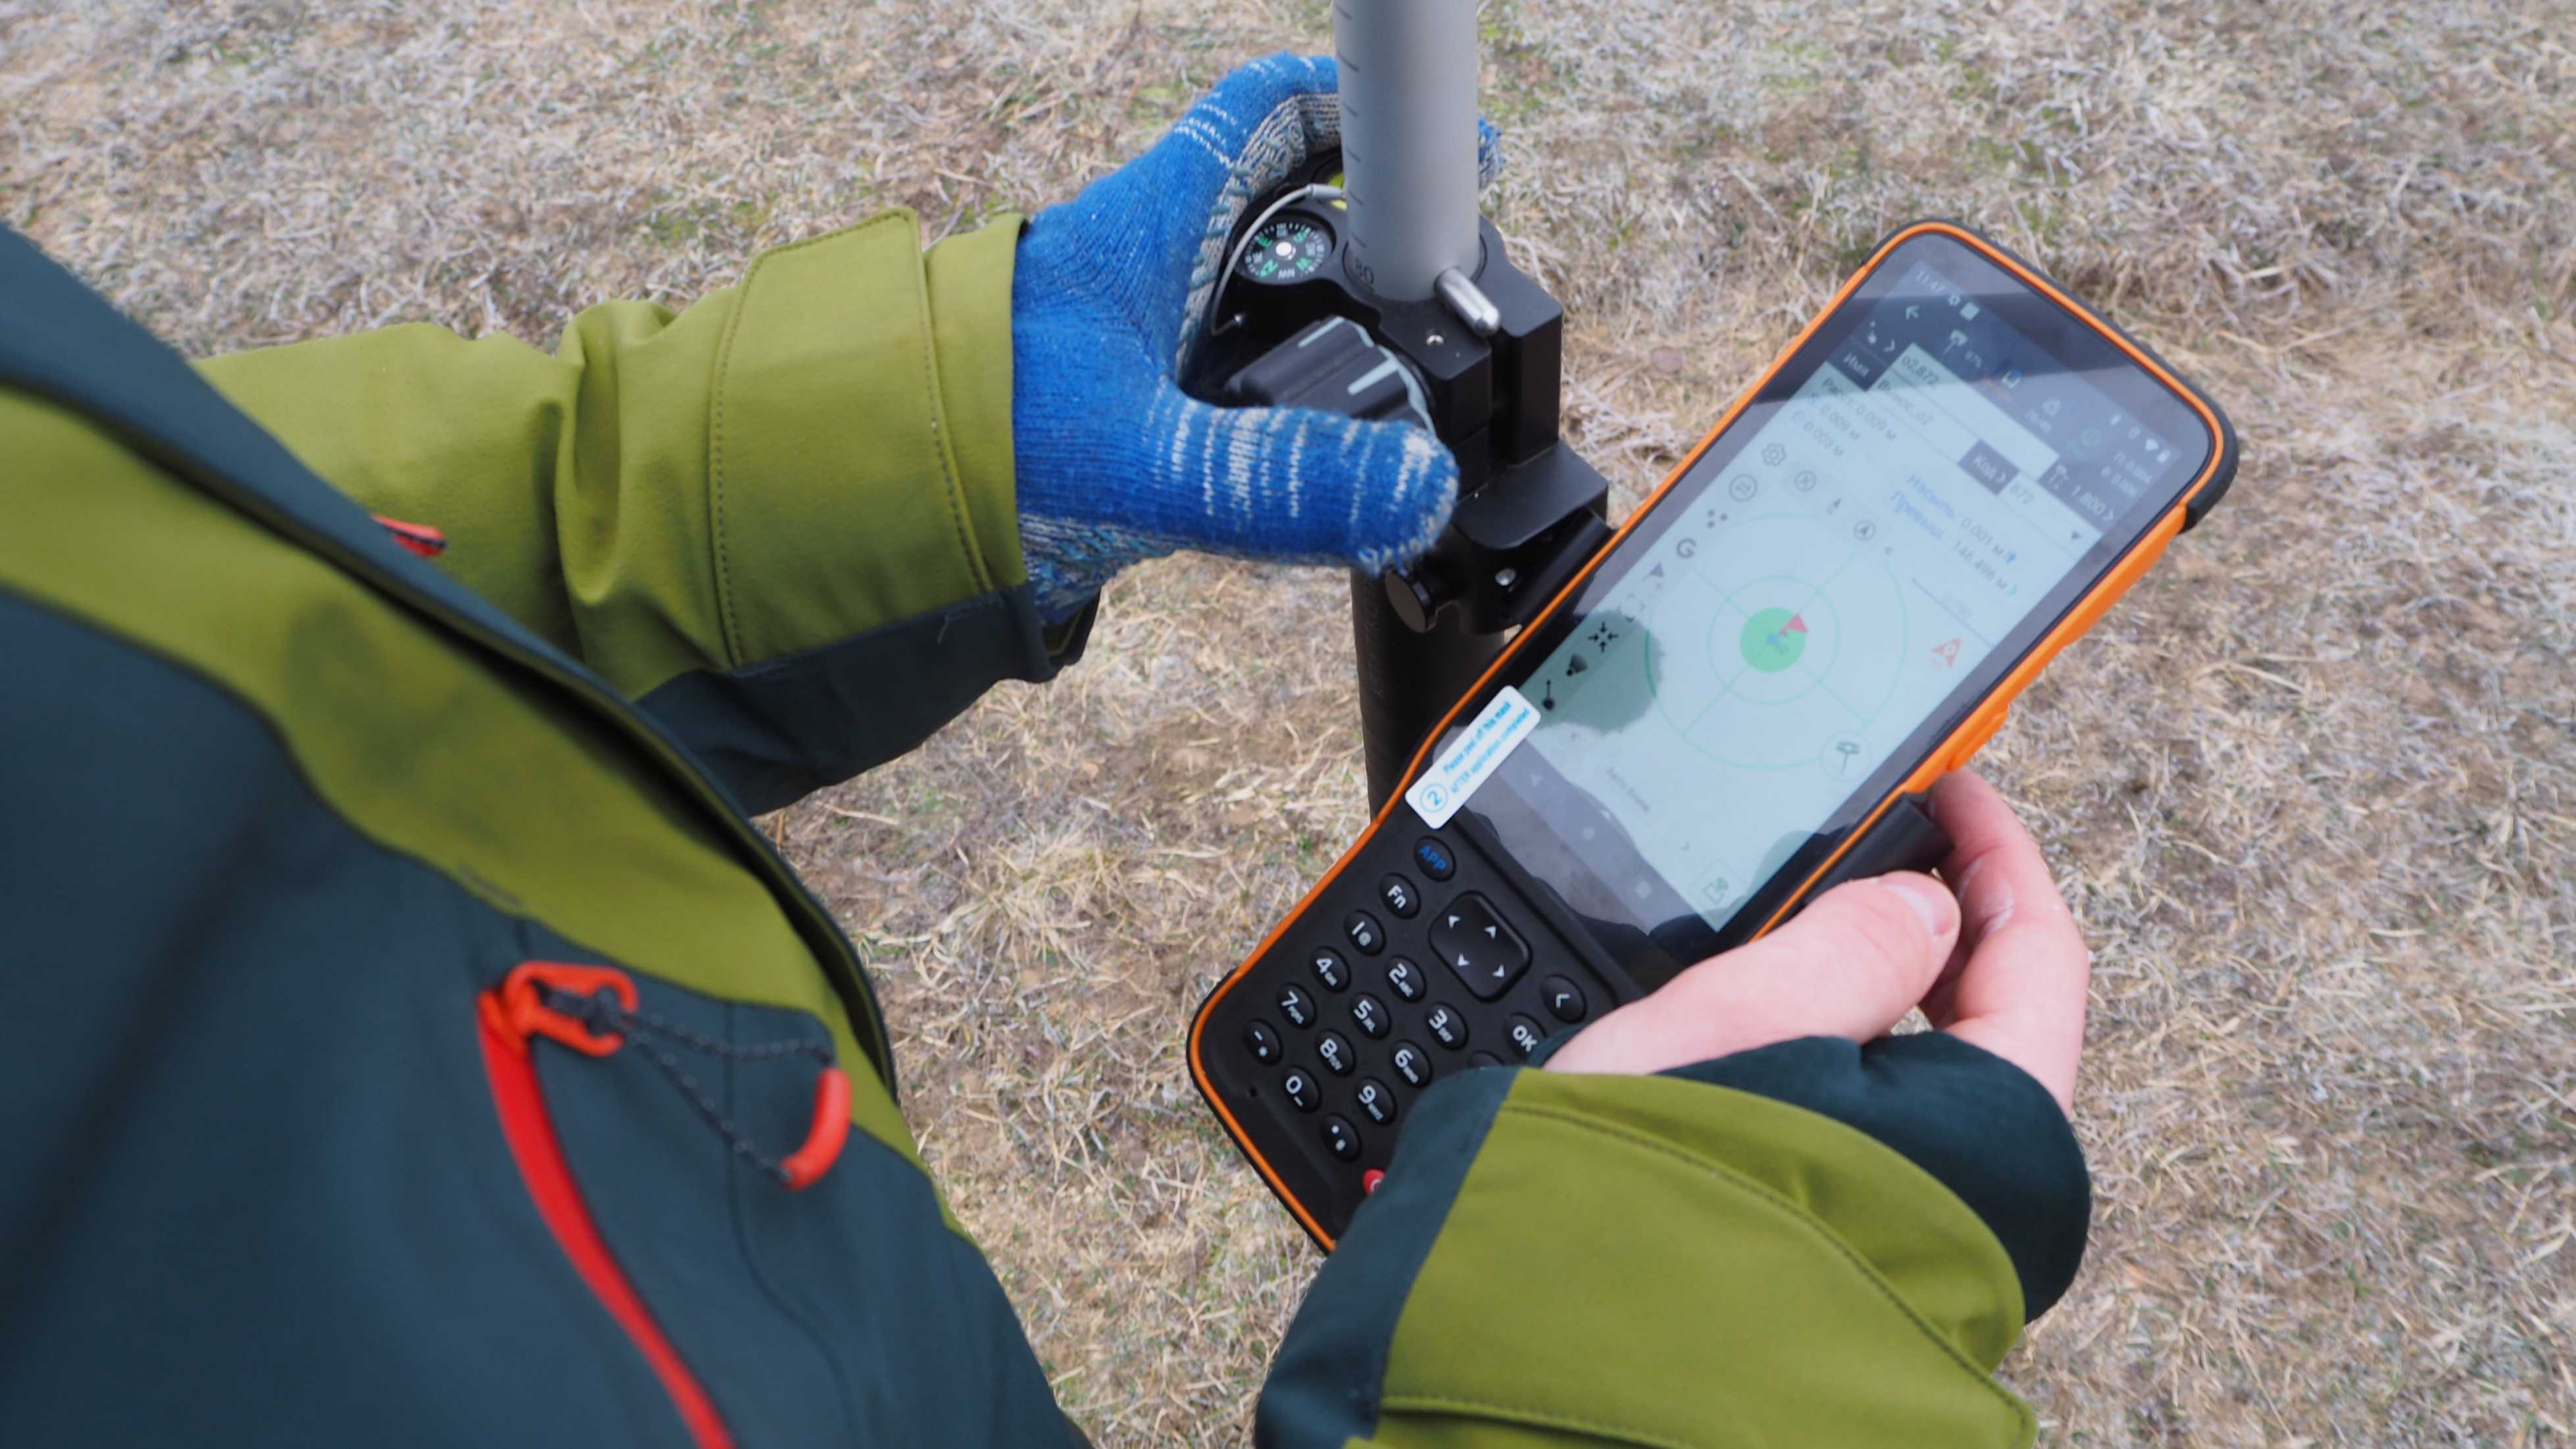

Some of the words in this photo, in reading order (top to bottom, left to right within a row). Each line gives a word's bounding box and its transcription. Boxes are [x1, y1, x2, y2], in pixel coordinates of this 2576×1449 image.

[1427, 789, 1443, 806] 2
[1420, 845, 1447, 871] APP
[1387, 885, 1406, 909] Fn
[1389, 963, 1408, 984] 2
[1354, 999, 1373, 1019] 5
[1428, 1009, 1448, 1029] 3
[1512, 1025, 1537, 1052] OK
[1395, 1048, 1414, 1068] 6
[1358, 1085, 1376, 1104] 9
